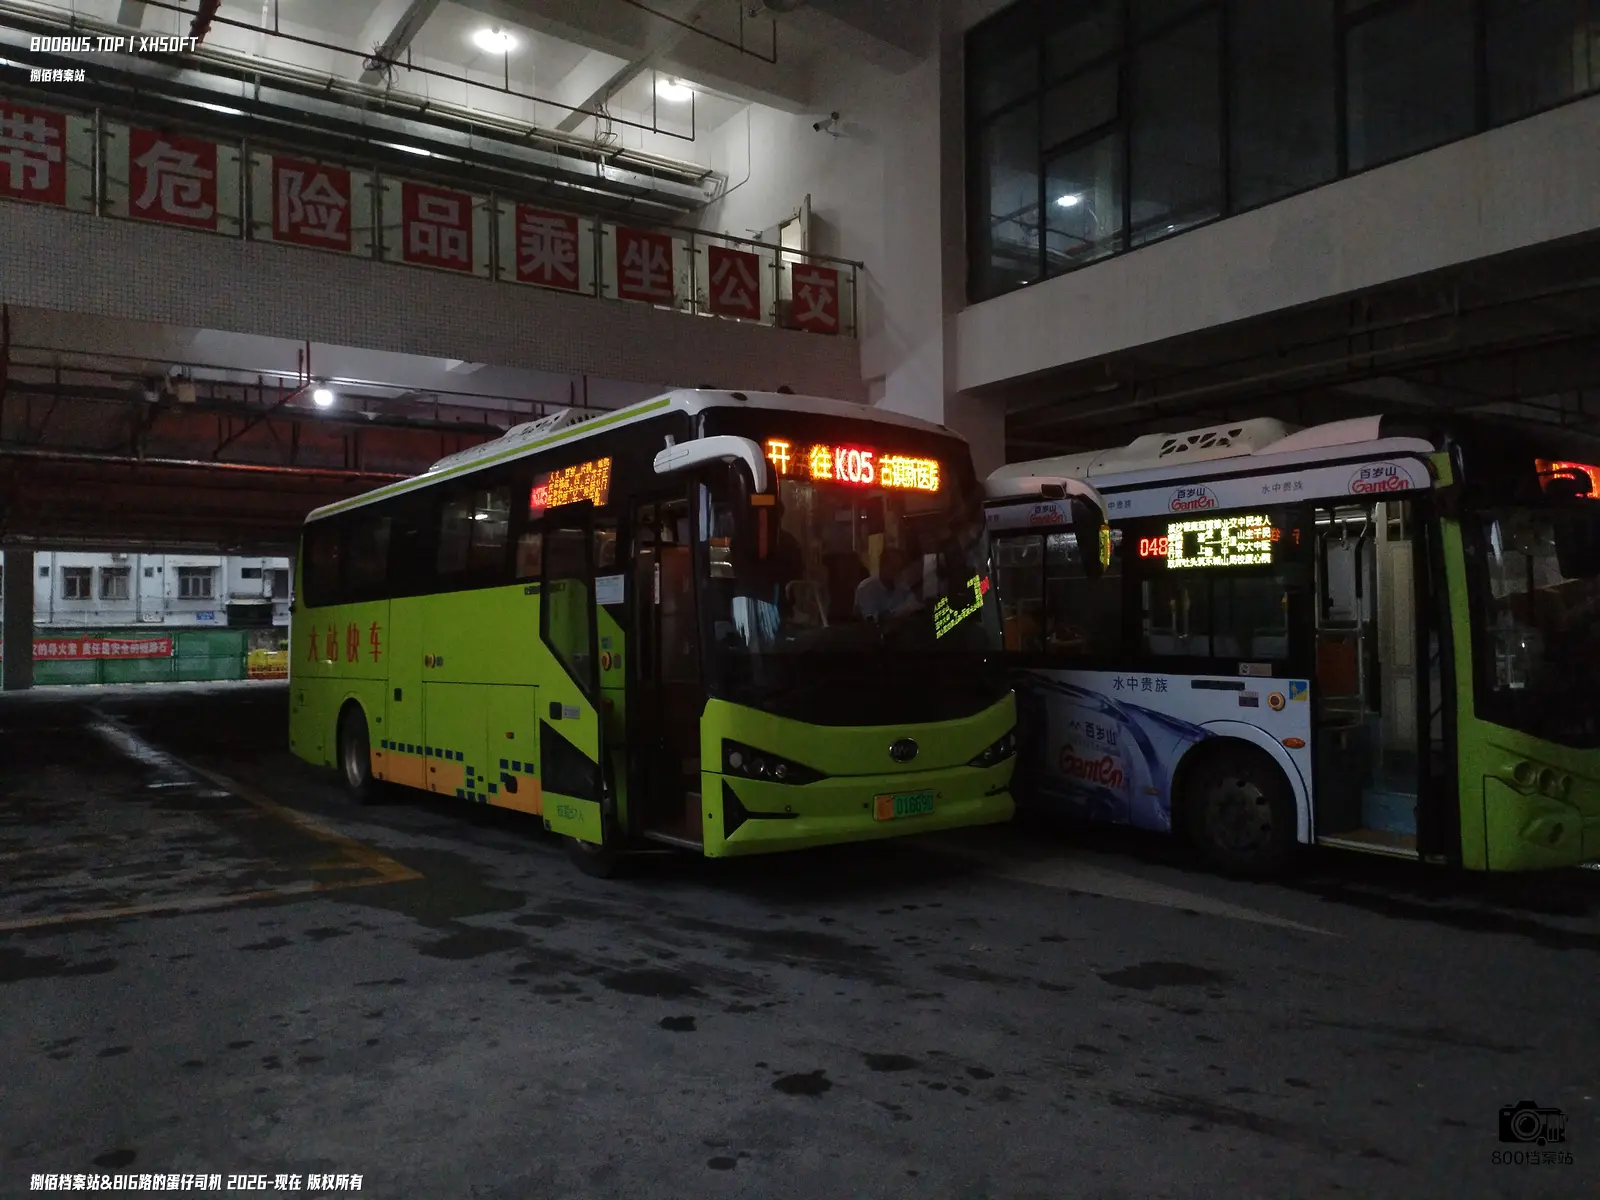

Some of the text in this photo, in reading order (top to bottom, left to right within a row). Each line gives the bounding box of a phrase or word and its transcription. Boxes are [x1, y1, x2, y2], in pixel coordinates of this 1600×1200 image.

[836, 446, 874, 483] K05
[1360, 467, 1397, 480] 百岁山
[1140, 537, 1169, 557] 048
[307, 620, 383, 663] 大站快车
[1113, 675, 1168, 693] 水中贵族
